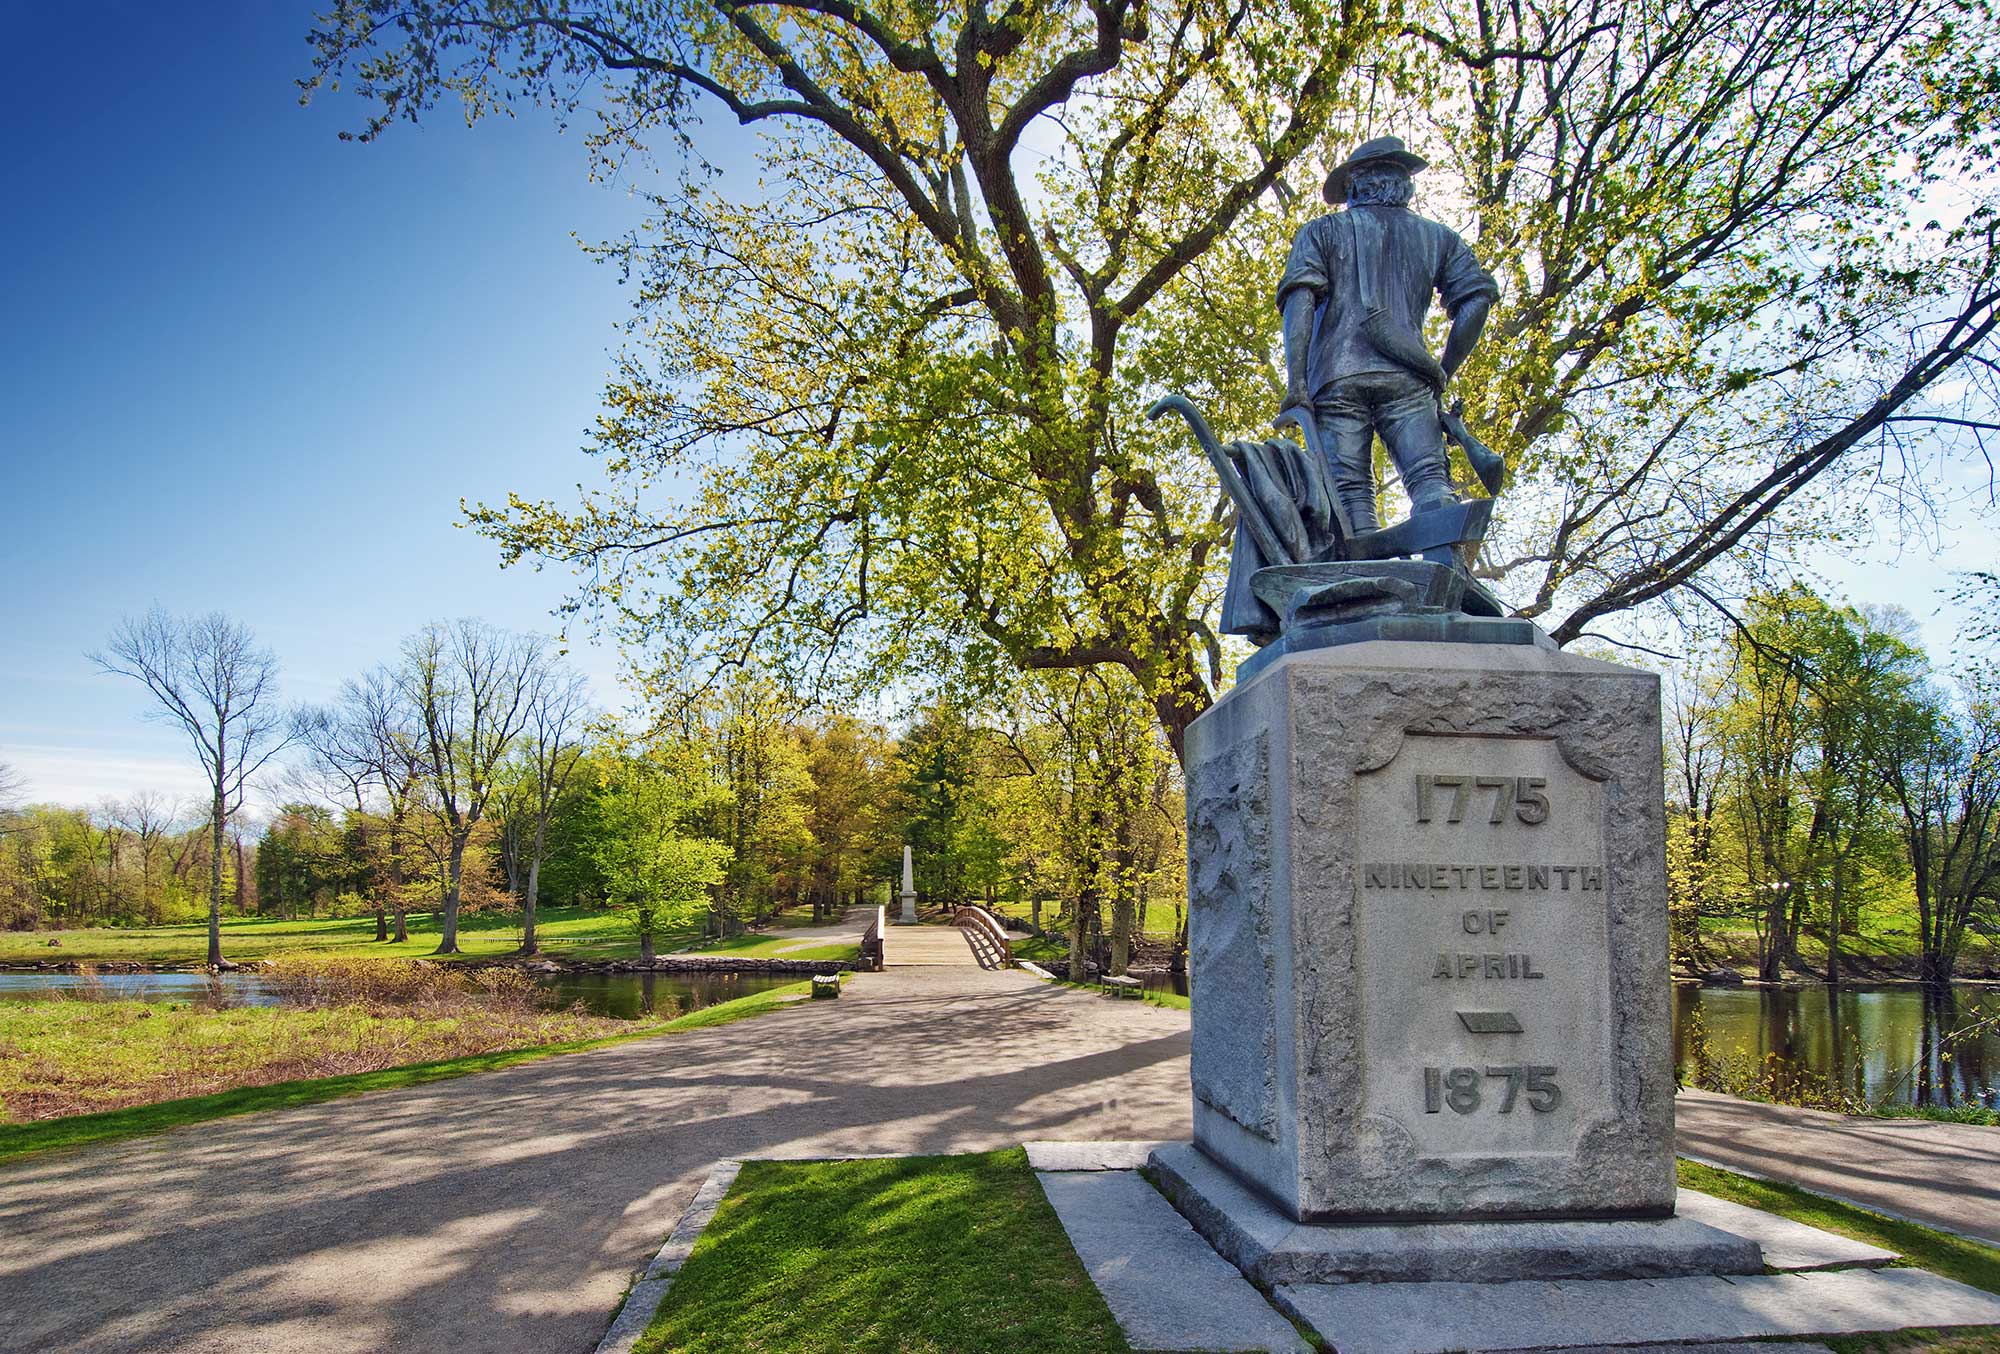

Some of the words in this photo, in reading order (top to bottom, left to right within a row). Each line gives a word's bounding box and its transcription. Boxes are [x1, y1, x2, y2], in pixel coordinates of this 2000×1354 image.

[1416, 774, 1550, 824] 1775
[1364, 864, 1602, 890] NINETEENTH
[1462, 910, 1510, 934] OF
[1432, 953, 1543, 979] APRIL
[1424, 1066, 1561, 1114] 1875
